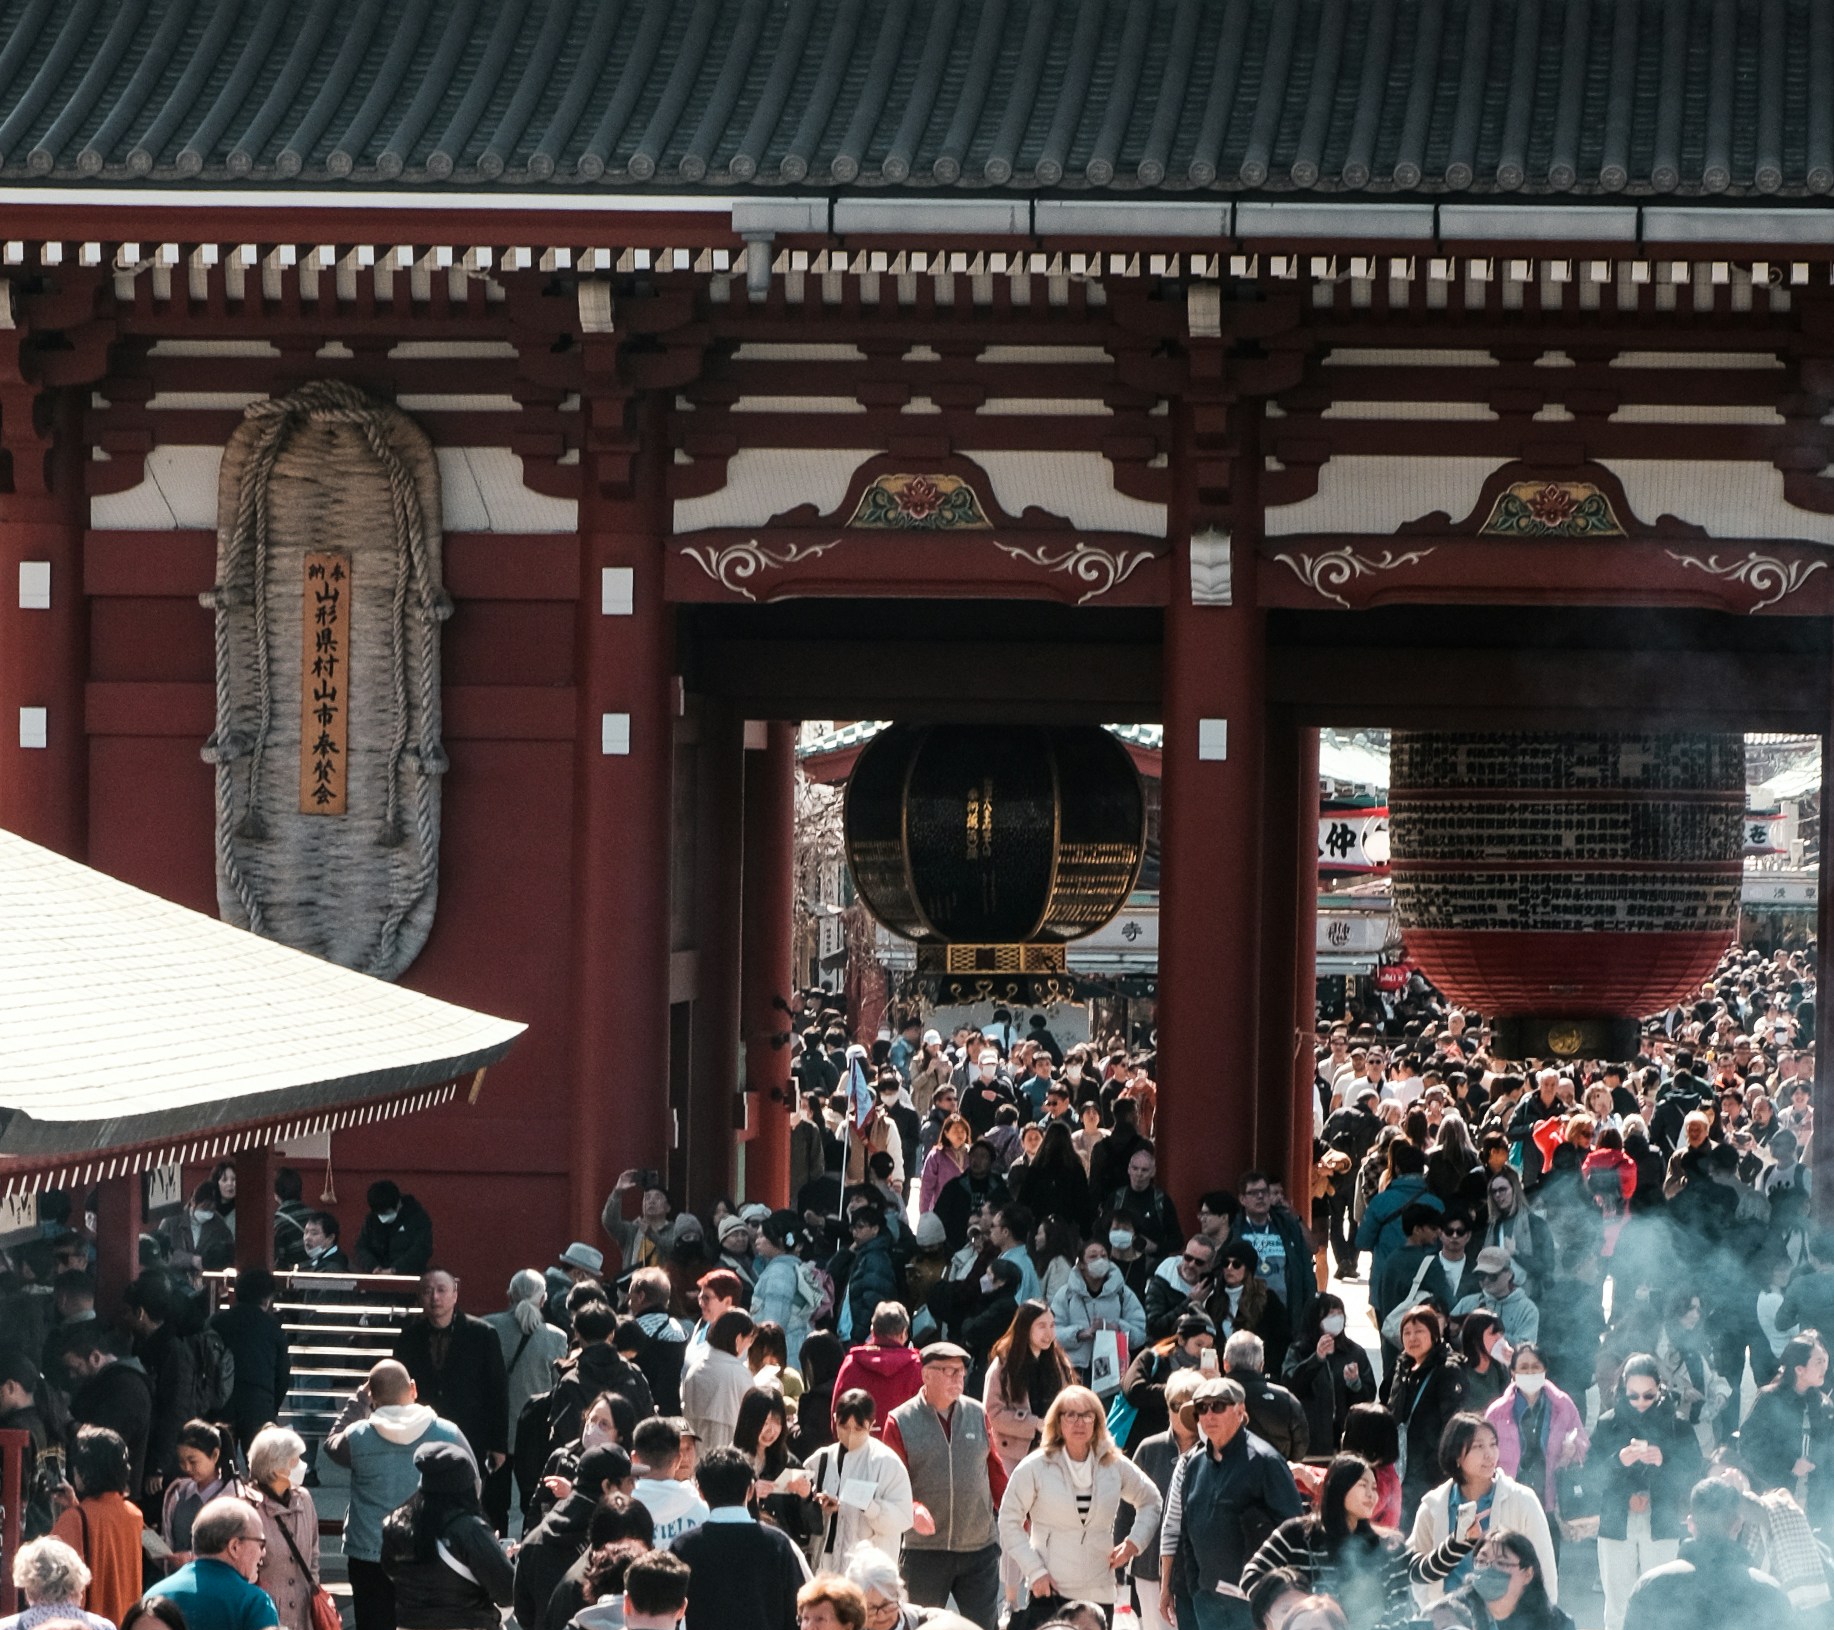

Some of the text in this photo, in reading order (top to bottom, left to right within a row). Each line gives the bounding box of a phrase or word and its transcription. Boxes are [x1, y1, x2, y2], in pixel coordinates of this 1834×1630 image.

[311, 581, 340, 805] 山形県村山市奉賛会
